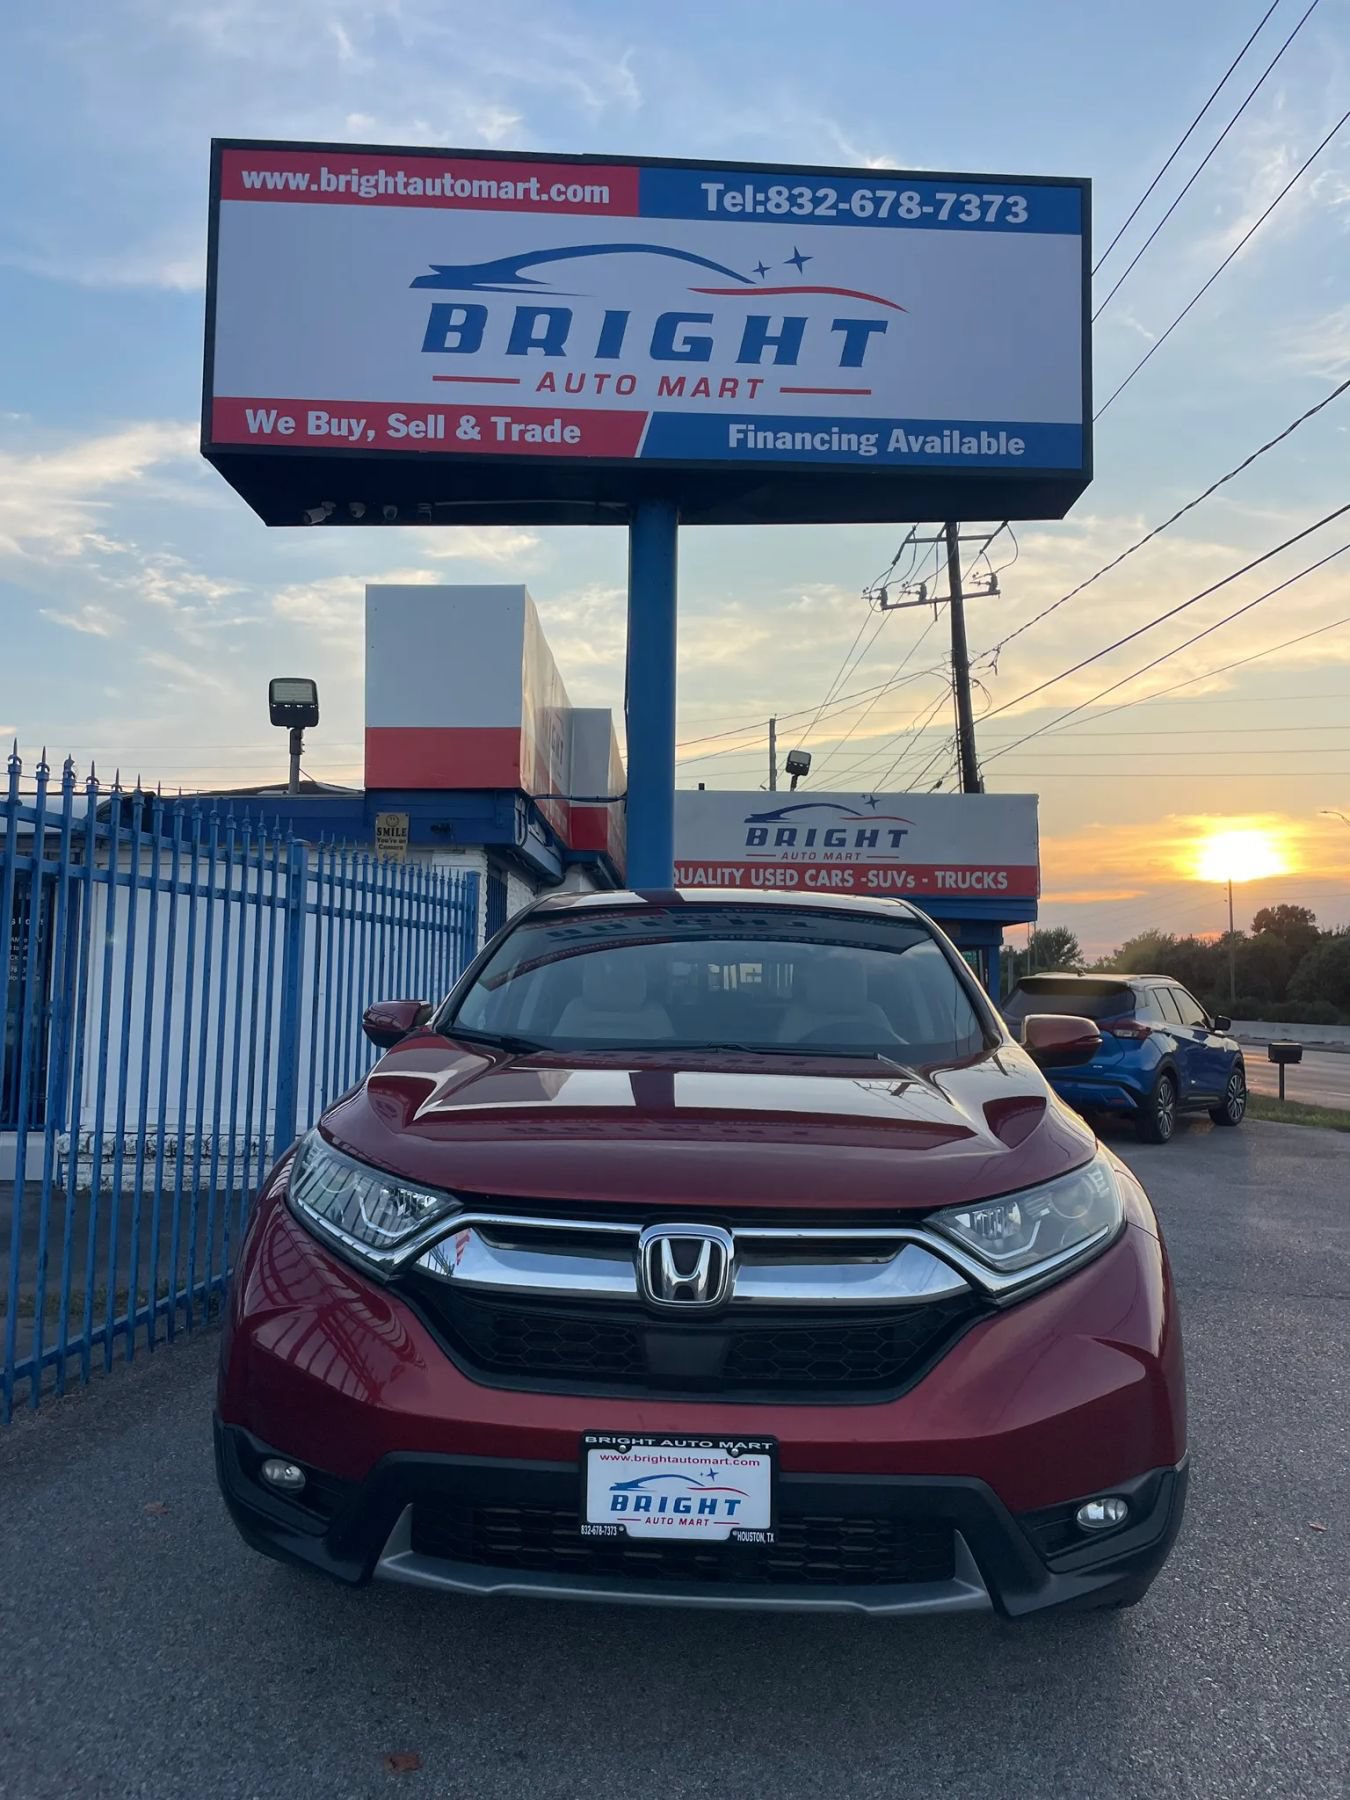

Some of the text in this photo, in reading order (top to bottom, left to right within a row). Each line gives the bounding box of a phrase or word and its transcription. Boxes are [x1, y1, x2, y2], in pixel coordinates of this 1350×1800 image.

[242, 167, 610, 204] www.brightautomart.com
[700, 182, 1029, 224] Tel:832-678-7373
[421, 302, 889, 368] BRIGHT
[535, 372, 764, 399] AUTO MART
[245, 408, 581, 444] We Buy, Sell & Trade
[728, 423, 1026, 456] Financing Available
[376, 827, 407, 837] SMILE
[745, 827, 909, 849] BRIGHT
[781, 851, 862, 861] AUTO MART
[750, 868, 799, 888] USED
[804, 868, 854, 888] CARS
[935, 871, 1009, 890] TRUCKS
[585, 1436, 773, 1450] BRIGHT AUTO MART
[600, 1453, 760, 1467] www.brightautomart.com
[610, 1494, 742, 1516] BRIGHT
[580, 1525, 617, 1536] 832-678-7373
[645, 1517, 710, 1527] AUTO MART
[737, 1531, 775, 1544] HOUSTON, TX
